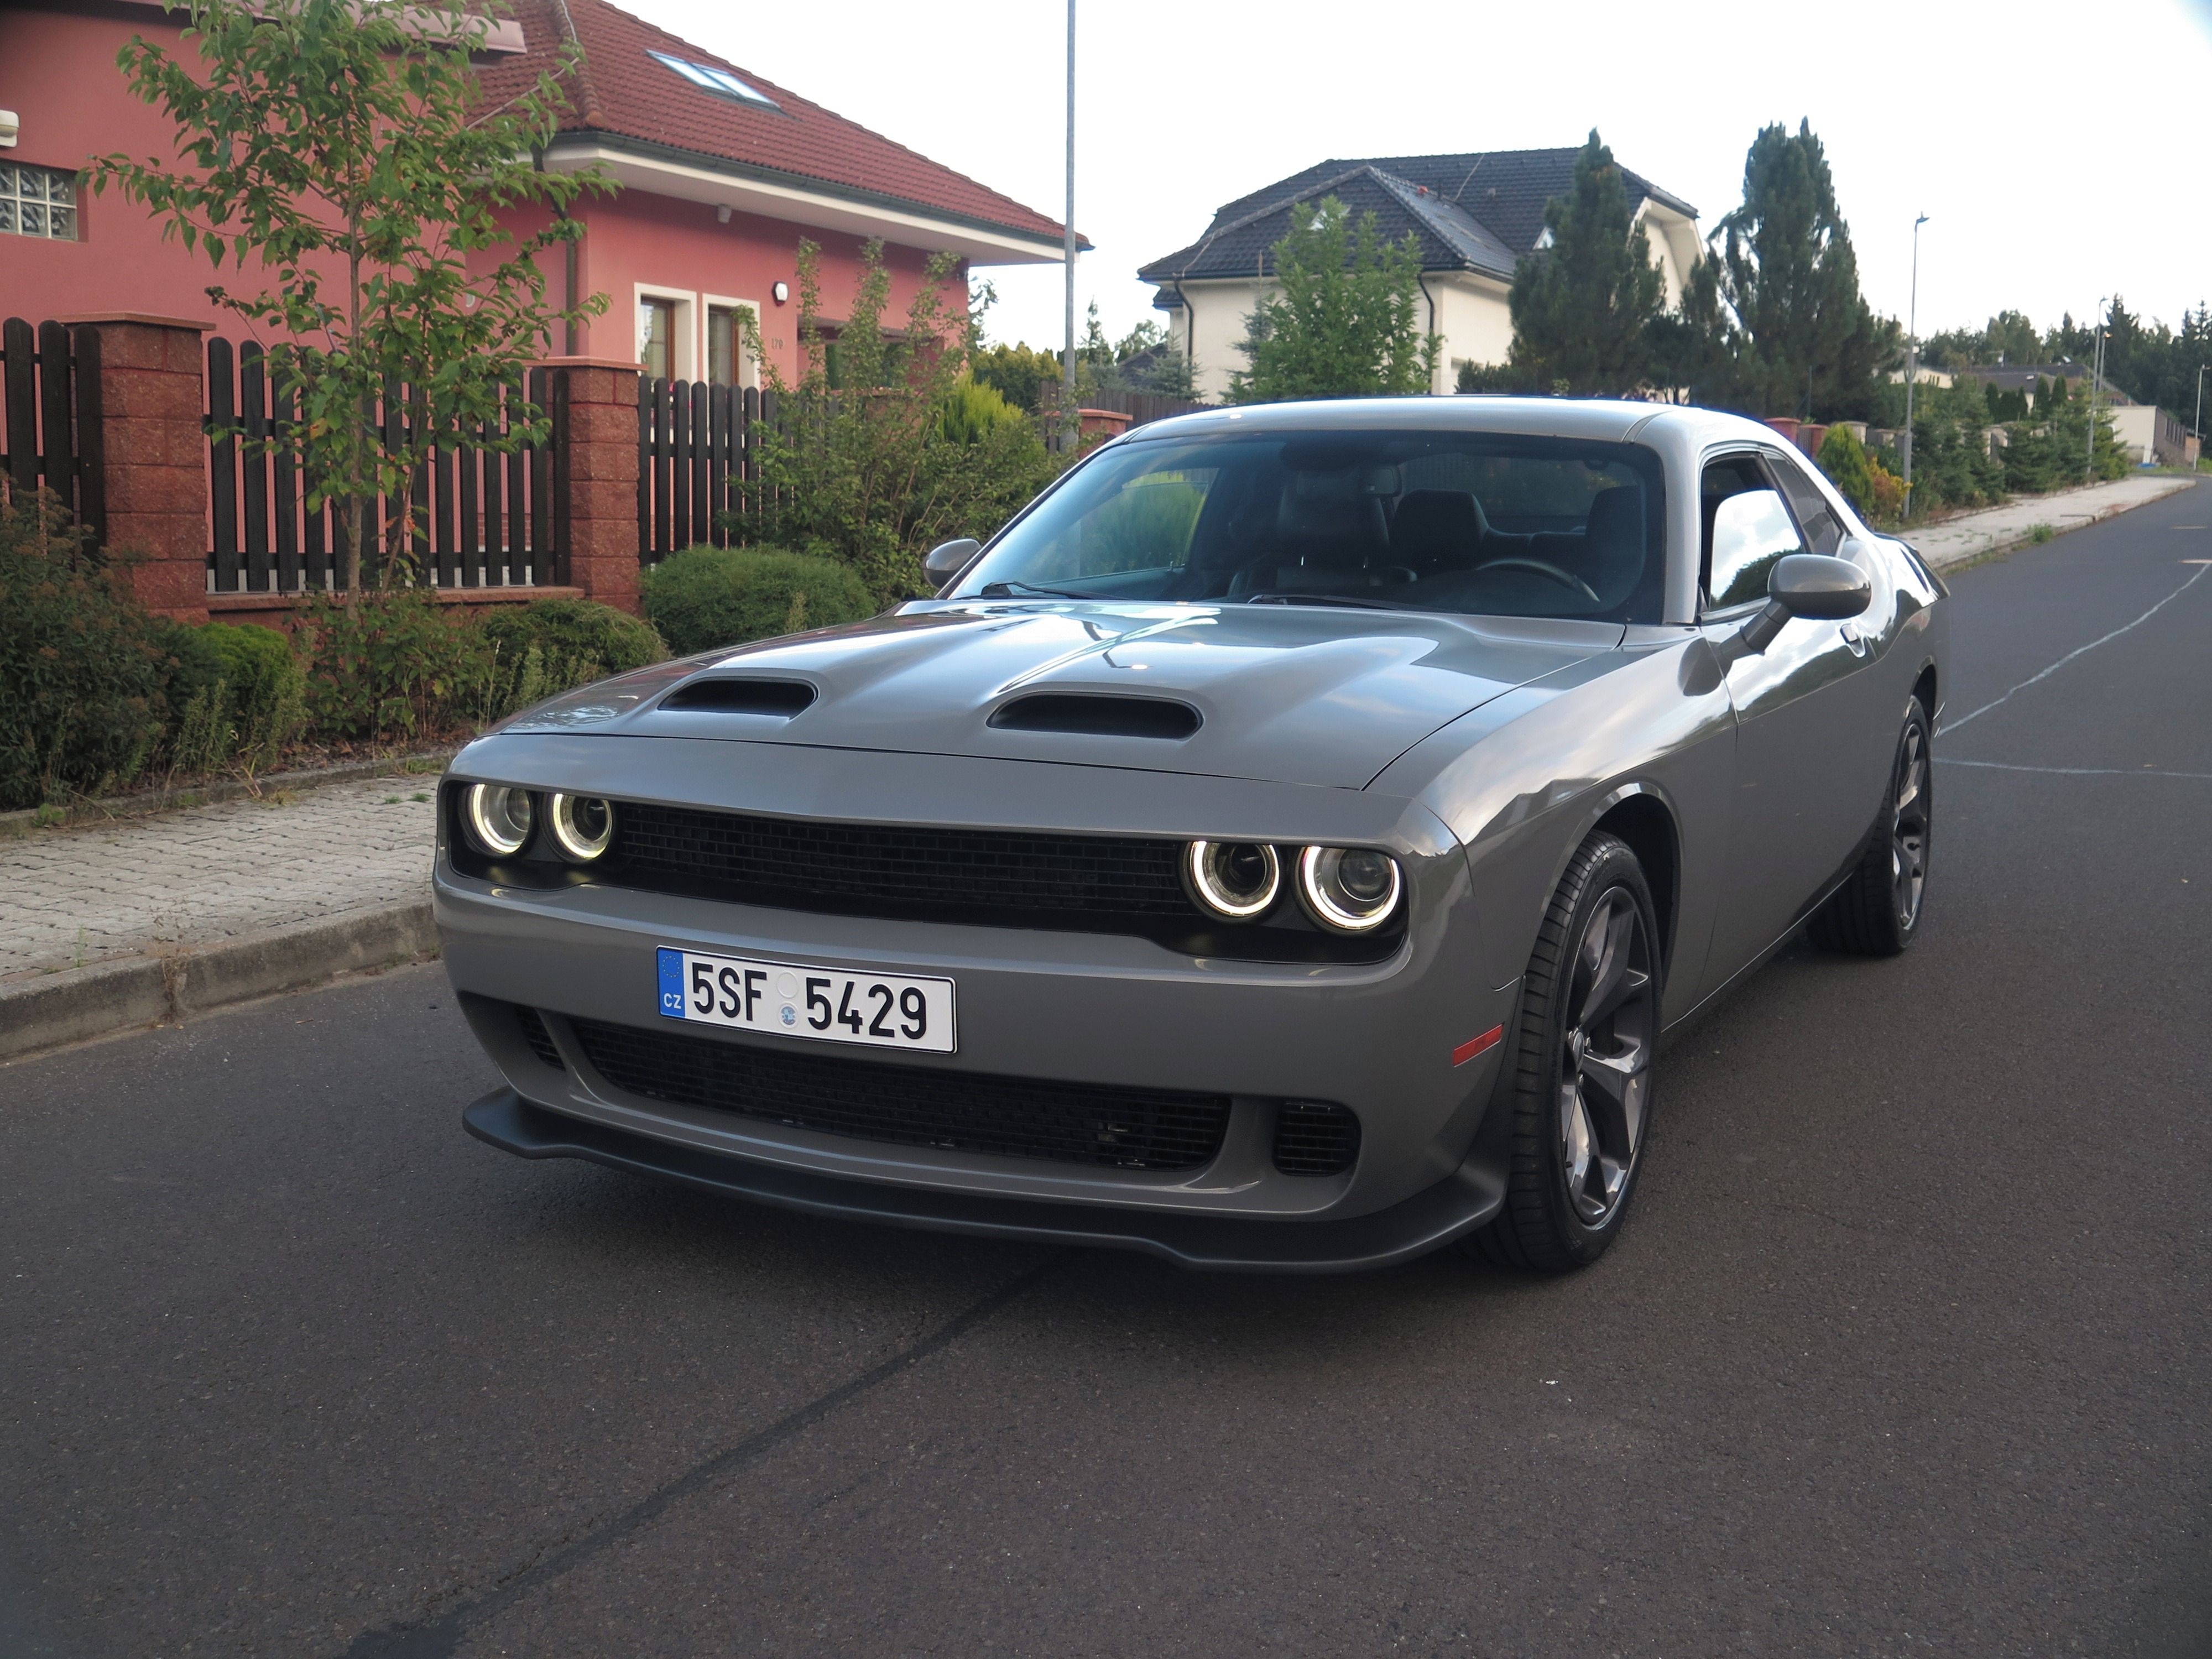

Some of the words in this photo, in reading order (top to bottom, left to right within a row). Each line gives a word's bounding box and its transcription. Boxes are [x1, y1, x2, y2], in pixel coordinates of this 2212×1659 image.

[664, 993, 682, 1009] CZ
[692, 962, 767, 1021] 5SF
[806, 977, 927, 1040] 5429
